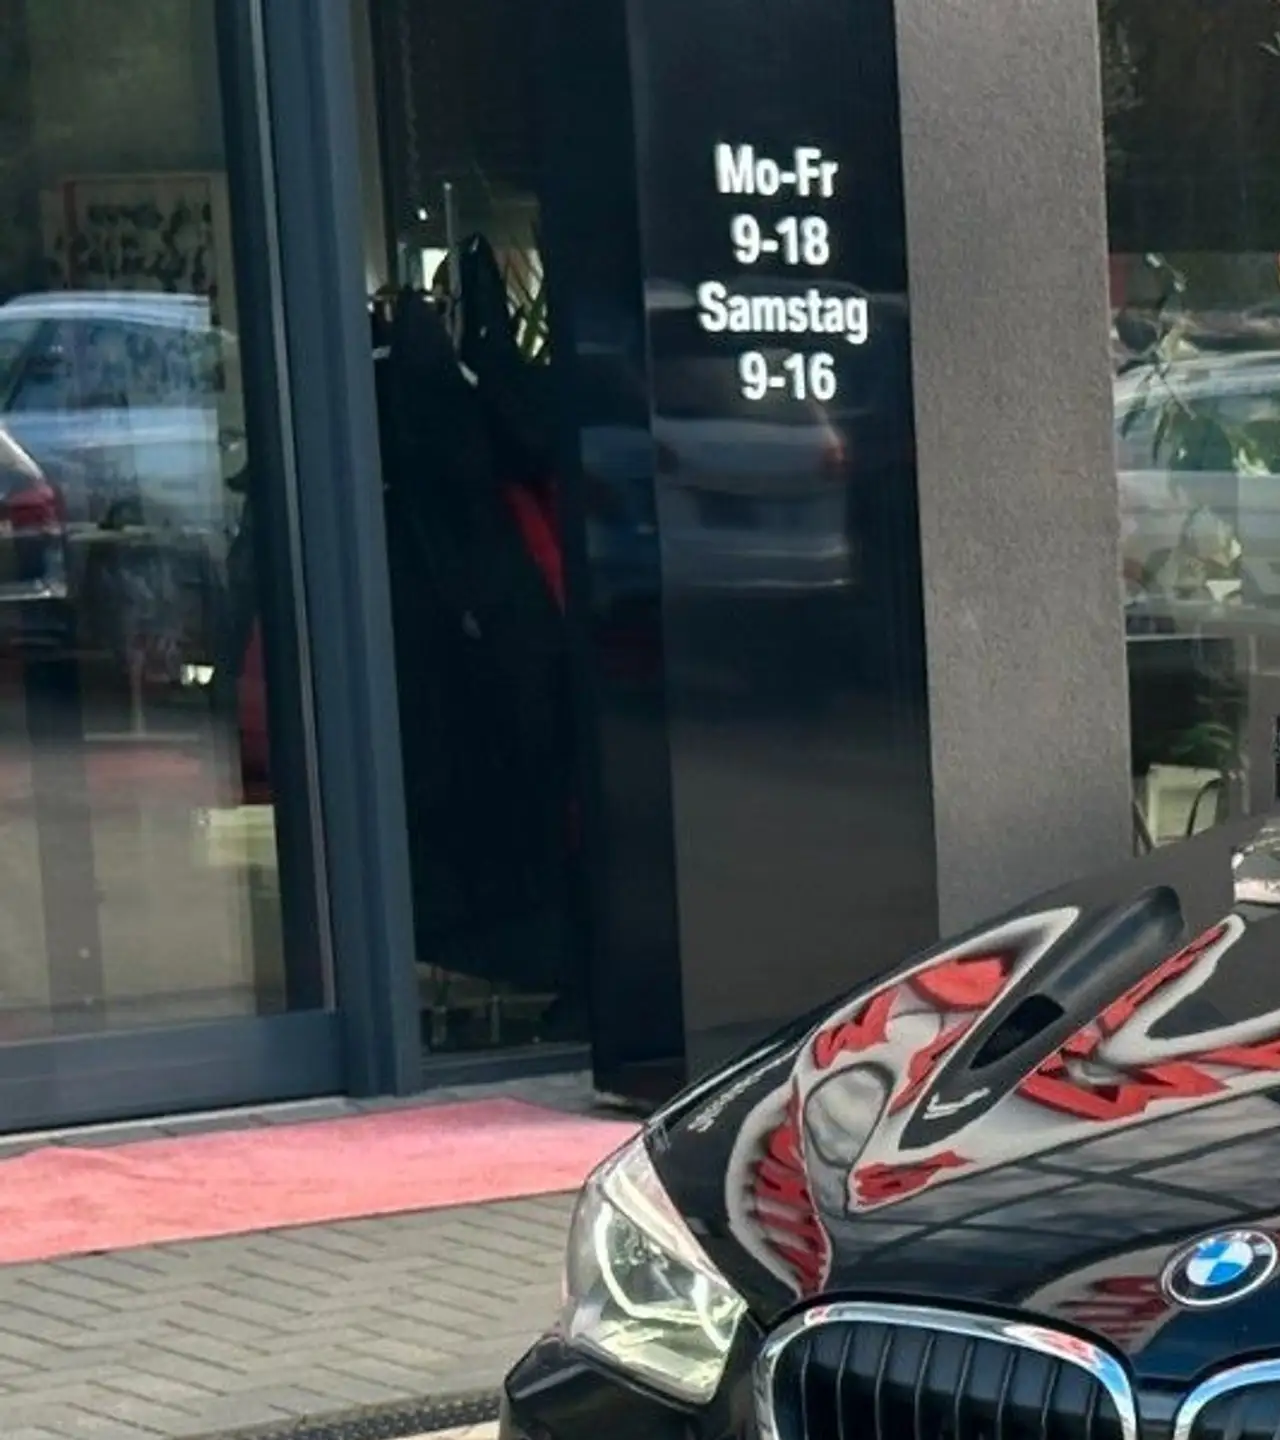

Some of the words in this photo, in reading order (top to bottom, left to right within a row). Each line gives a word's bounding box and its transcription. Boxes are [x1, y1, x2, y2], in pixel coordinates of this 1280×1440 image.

[715, 143, 839, 198] Mo-Fr
[730, 213, 830, 266] 9-18
[697, 280, 869, 345] Samstag
[739, 350, 839, 401] 9-16
